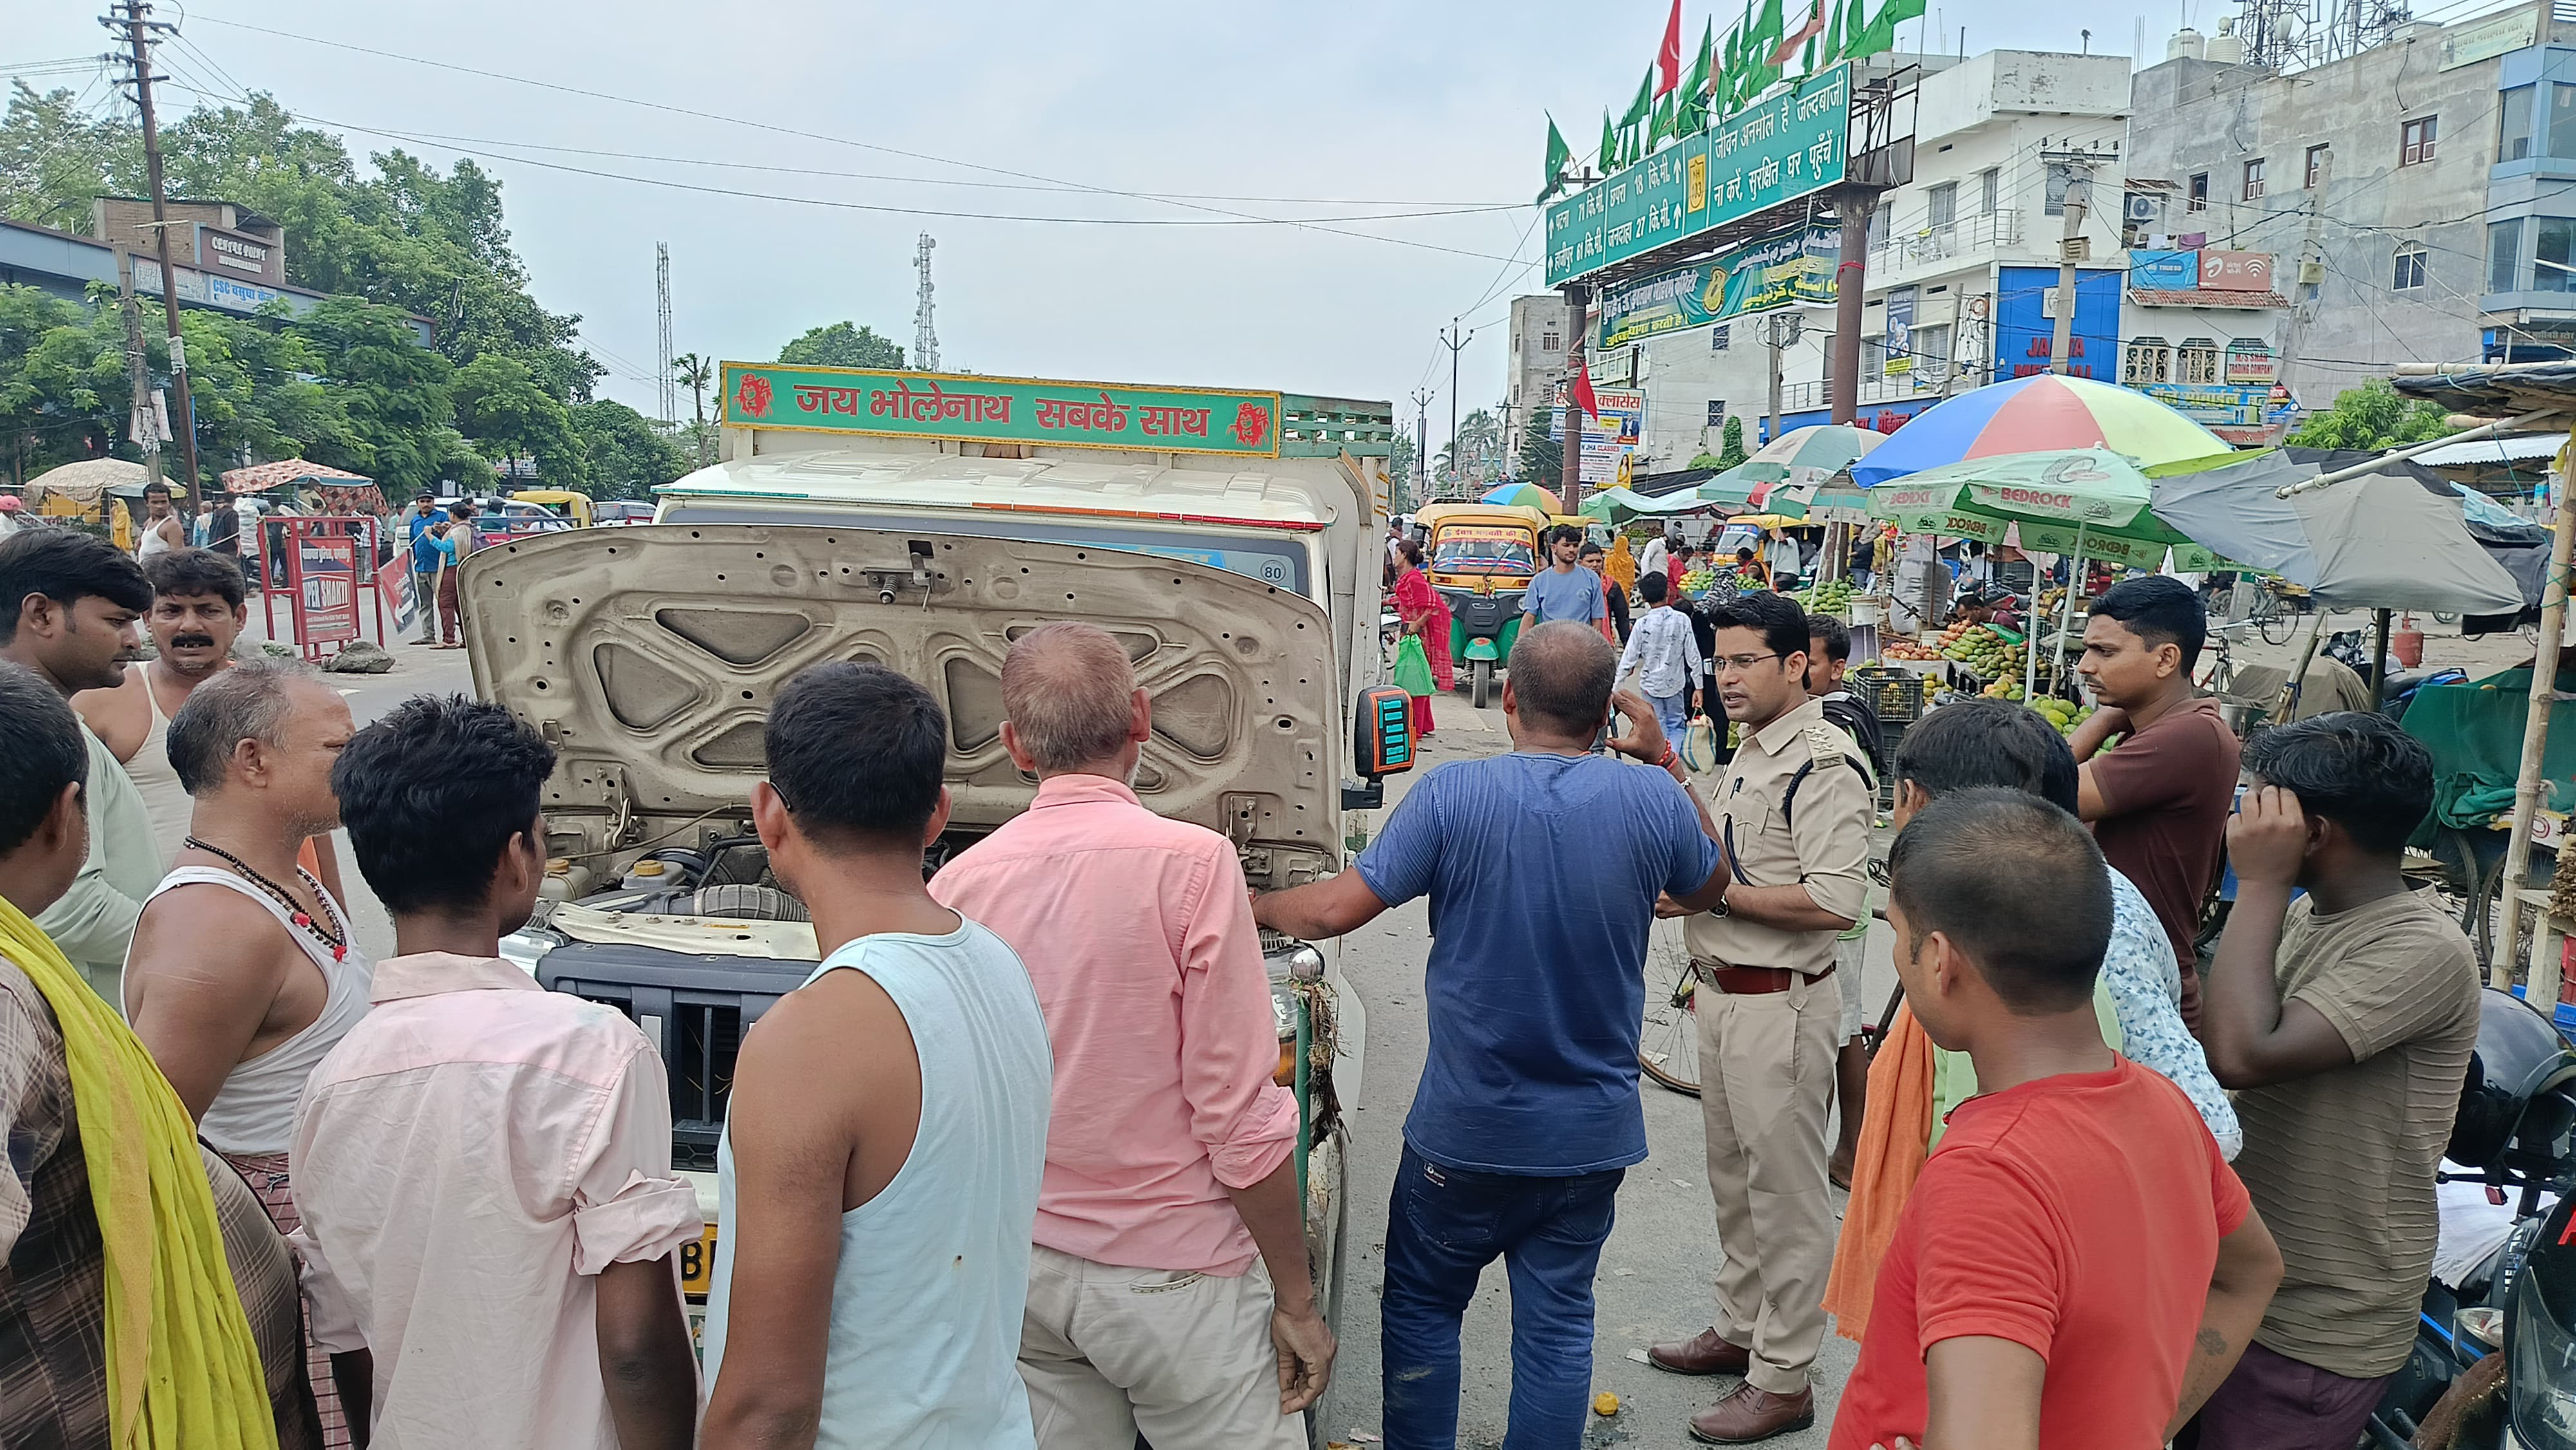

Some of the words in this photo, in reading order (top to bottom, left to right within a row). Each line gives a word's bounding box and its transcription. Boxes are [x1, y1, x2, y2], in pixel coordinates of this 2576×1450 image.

[1715, 127, 1738, 159] जीवन
[1740, 107, 1774, 147] अनमोल
[1781, 97, 1790, 133] है
[1797, 70, 1844, 122] जल्दबाजी
[1610, 183, 1627, 207] छपरा
[1634, 174, 1643, 195] 18
[1713, 184, 1724, 207] ना
[1748, 156, 1779, 201] सुरक्षित
[1787, 151, 1802, 178] घर
[1555, 209, 1569, 232] पटना
[1578, 202, 1585, 222] 71
[1608, 221, 1633, 248] जनदाहा
[1636, 216, 1646, 238] 27
[1577, 243, 1584, 261] 61
[213, 279, 231, 294] CSC
[231, 285, 256, 301] वसुधा
[2027, 337, 2085, 357] JATA
[2251, 363, 2273, 375] COMPANY
[793, 383, 861, 417] जय
[869, 379, 1014, 424] भोलेनाथ
[1034, 391, 1131, 433] सबके
[1139, 405, 1211, 437] साथ
[1598, 391, 1642, 409] क्लासेस
[2001, 487, 2073, 509] BEDROCK
[1264, 567, 1282, 579] 80
[302, 579, 321, 608] UPER
[321, 580, 348, 607] SHAKTI
